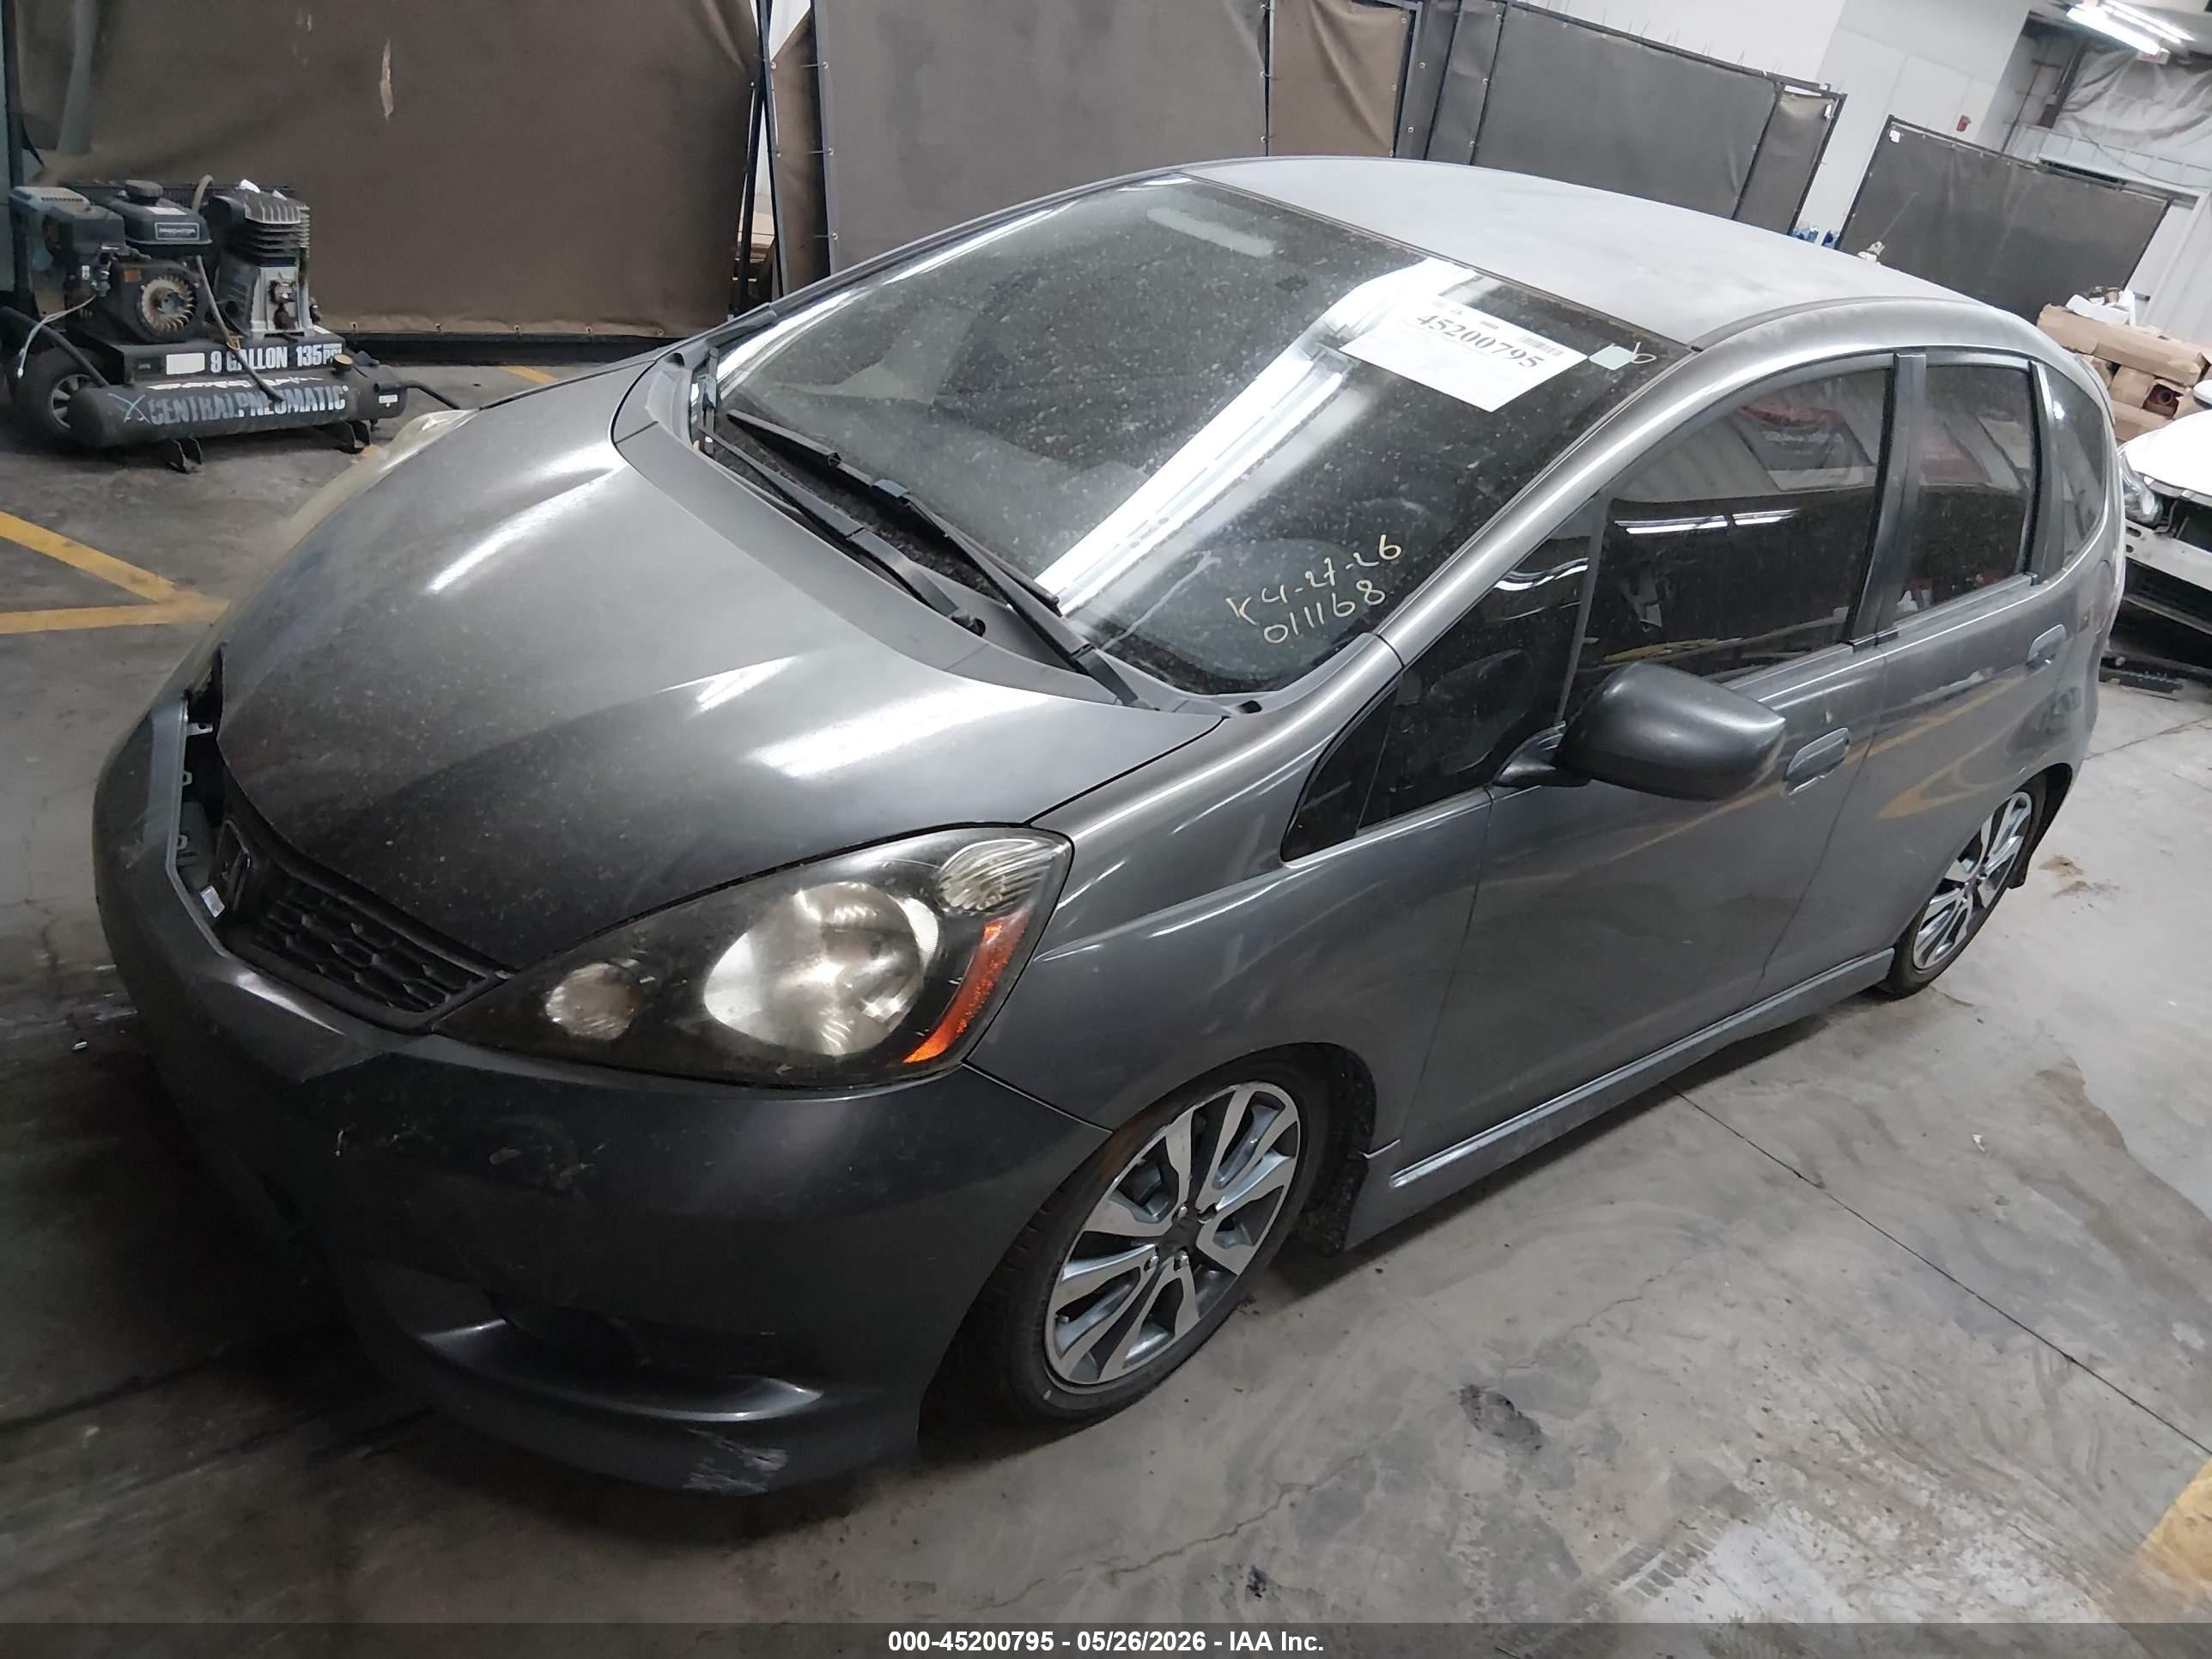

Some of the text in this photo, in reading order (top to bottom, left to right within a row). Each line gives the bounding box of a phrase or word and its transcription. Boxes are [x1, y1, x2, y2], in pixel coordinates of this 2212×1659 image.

[210, 350, 222, 373] 9
[226, 346, 288, 372] GALLON
[1417, 315, 1545, 368] 45200795
